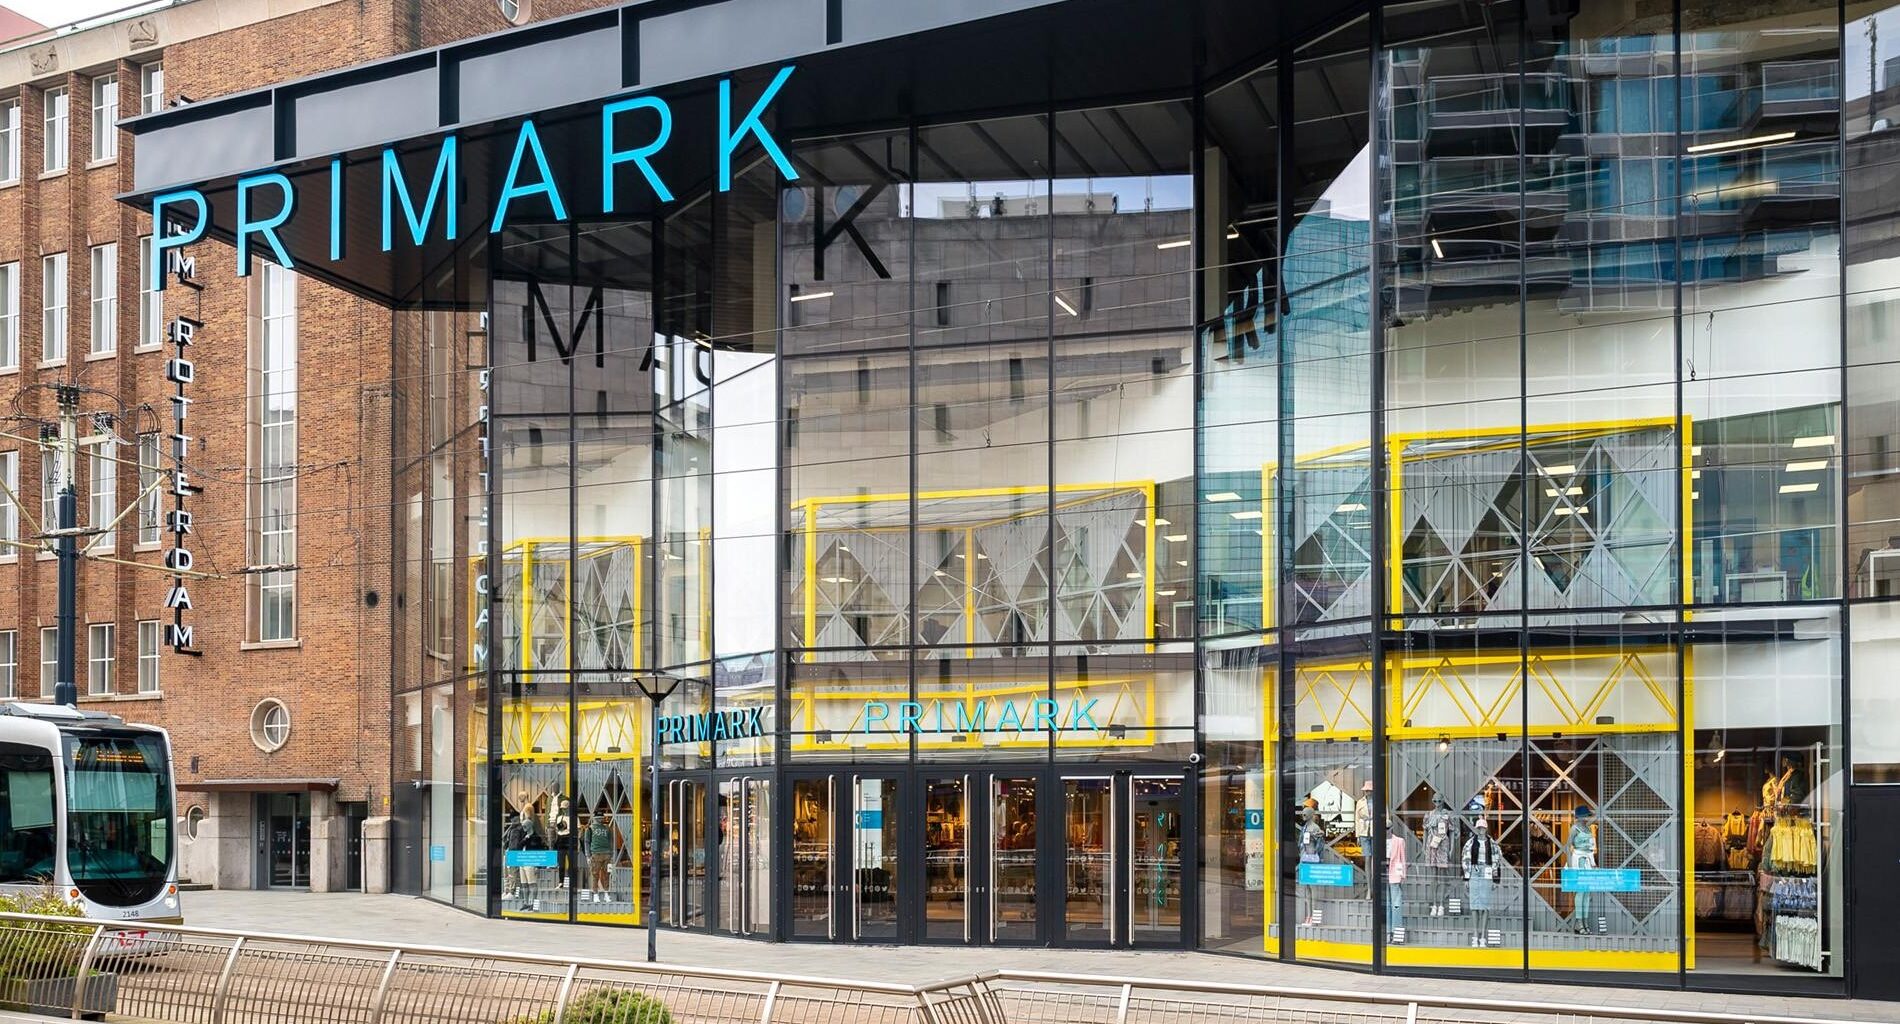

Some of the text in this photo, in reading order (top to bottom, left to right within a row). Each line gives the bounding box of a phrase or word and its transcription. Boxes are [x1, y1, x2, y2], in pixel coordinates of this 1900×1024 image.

[153, 66, 798, 291] PRIMARK
[170, 318, 194, 648] ROTTERDAM
[657, 706, 764, 745] PRIMARK
[864, 698, 1100, 735] PRIMARK
[1250, 812, 1261, 826] 0
[122, 910, 140, 918] 2148
